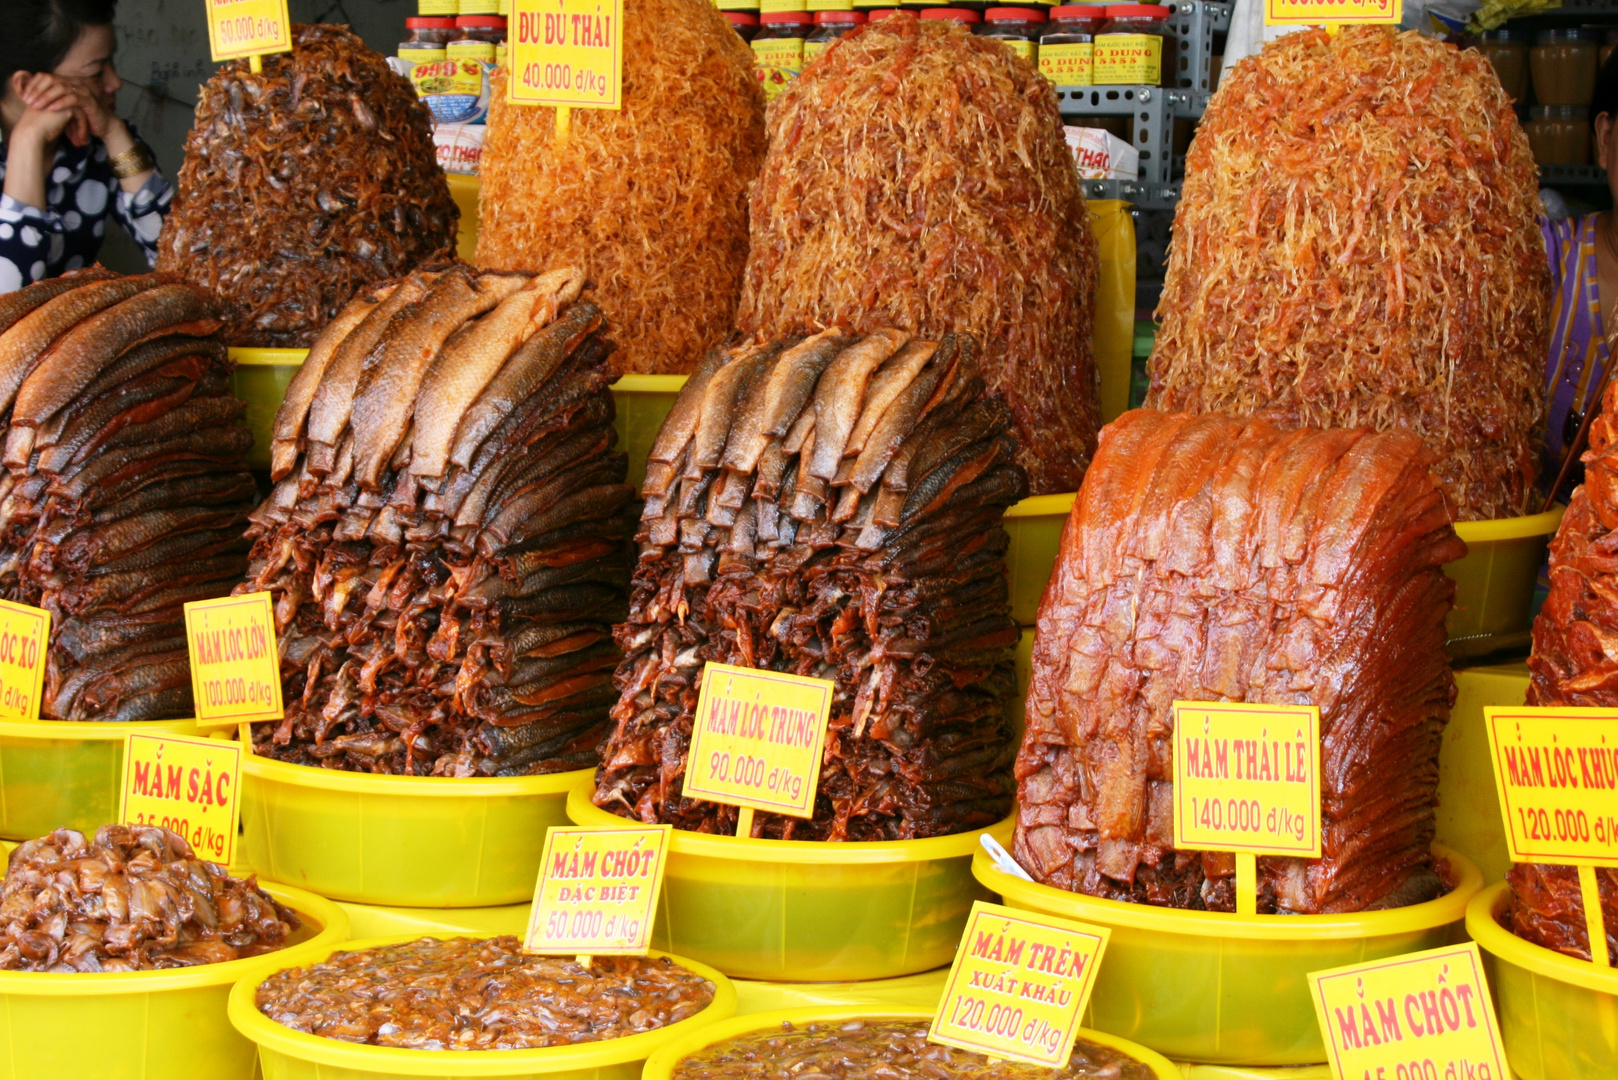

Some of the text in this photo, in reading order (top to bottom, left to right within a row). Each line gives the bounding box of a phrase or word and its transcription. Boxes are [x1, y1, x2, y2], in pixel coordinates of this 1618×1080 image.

[220, 16, 254, 43] 50.000
[257, 18, 279, 40] đ/kg
[519, 11, 540, 44] ĐU
[572, 5, 610, 48] THÁI
[1057, 58, 1095, 66] DUN
[1110, 49, 1152, 57] DUNG
[523, 62, 571, 90] 40.000
[575, 69, 606, 97] đ/kg
[196, 612, 222, 665] MẮM
[222, 618, 244, 662] LÓC
[4, 686, 28, 716] đ/kg
[203, 677, 272, 707] 100.000 đ/kg
[707, 678, 816, 748] MẮM LÓC TRUNG
[1186, 715, 1307, 783] MẮM THÁI LÊ
[1504, 721, 1545, 788] MẮM
[1543, 733, 1578, 789] LÓC
[132, 743, 230, 813] MẮM SẶC
[709, 751, 802, 800] 90.000 đ/kg
[1192, 797, 1304, 842] 140.000 đ/kg
[1518, 807, 1590, 843] 120.000
[192, 826, 224, 857] đ/kg
[550, 835, 655, 879] MẮM CHỐT
[558, 882, 640, 905] ĐẶC BIỆT
[546, 910, 640, 944] 50.000 đ/kg
[970, 921, 1089, 980] MẮM TRÈN
[969, 969, 1072, 1006] XUẤT KHẨU
[1334, 963, 1477, 1051] MẮM CHỐT
[950, 994, 1062, 1054] 120.000 đ/kg
